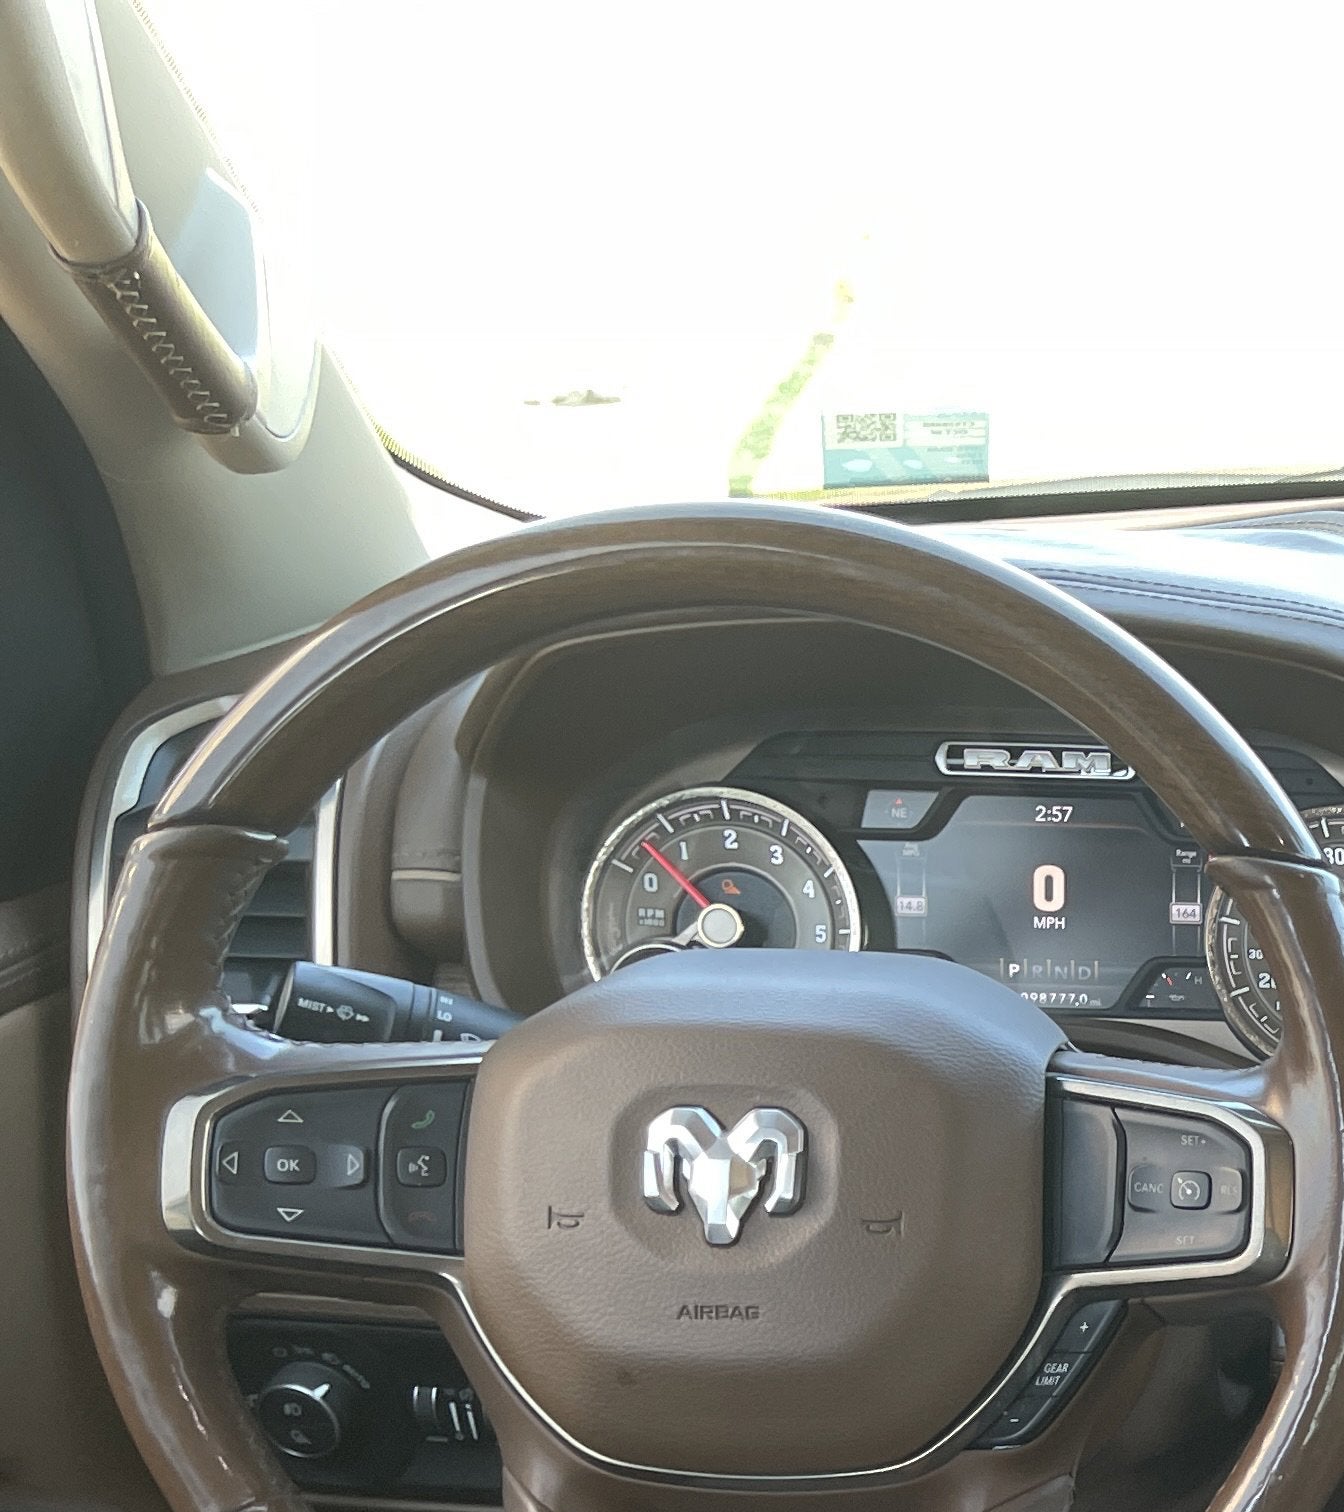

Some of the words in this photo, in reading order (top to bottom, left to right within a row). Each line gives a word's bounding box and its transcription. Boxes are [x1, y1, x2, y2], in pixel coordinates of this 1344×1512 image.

[963, 748, 1111, 776] RAM
[891, 808, 908, 819] NE
[1035, 805, 1073, 823] 2:57
[723, 829, 738, 849] 2
[679, 841, 688, 861] 1
[769, 844, 784, 865] 3
[643, 872, 658, 893] 0
[803, 879, 816, 899] 4
[1033, 864, 1065, 912] 0
[899, 901, 923, 911] 14.8
[1175, 908, 1197, 918] 164
[1033, 916, 1066, 930] MPH
[815, 925, 826, 943] 5
[1248, 949, 1264, 960] 30
[1008, 963, 1020, 978] P
[1032, 965, 1043, 978] R
[1054, 965, 1067, 979] N
[1078, 966, 1091, 980] D
[298, 997, 326, 1014] MIST
[437, 1010, 453, 1022] LO
[277, 1158, 300, 1172] OK
[1134, 1182, 1164, 1194] CANC
[676, 1304, 760, 1321] AIRBAG
[1044, 1363, 1069, 1373] GEAR
[1035, 1375, 1060, 1386] LIMIT
